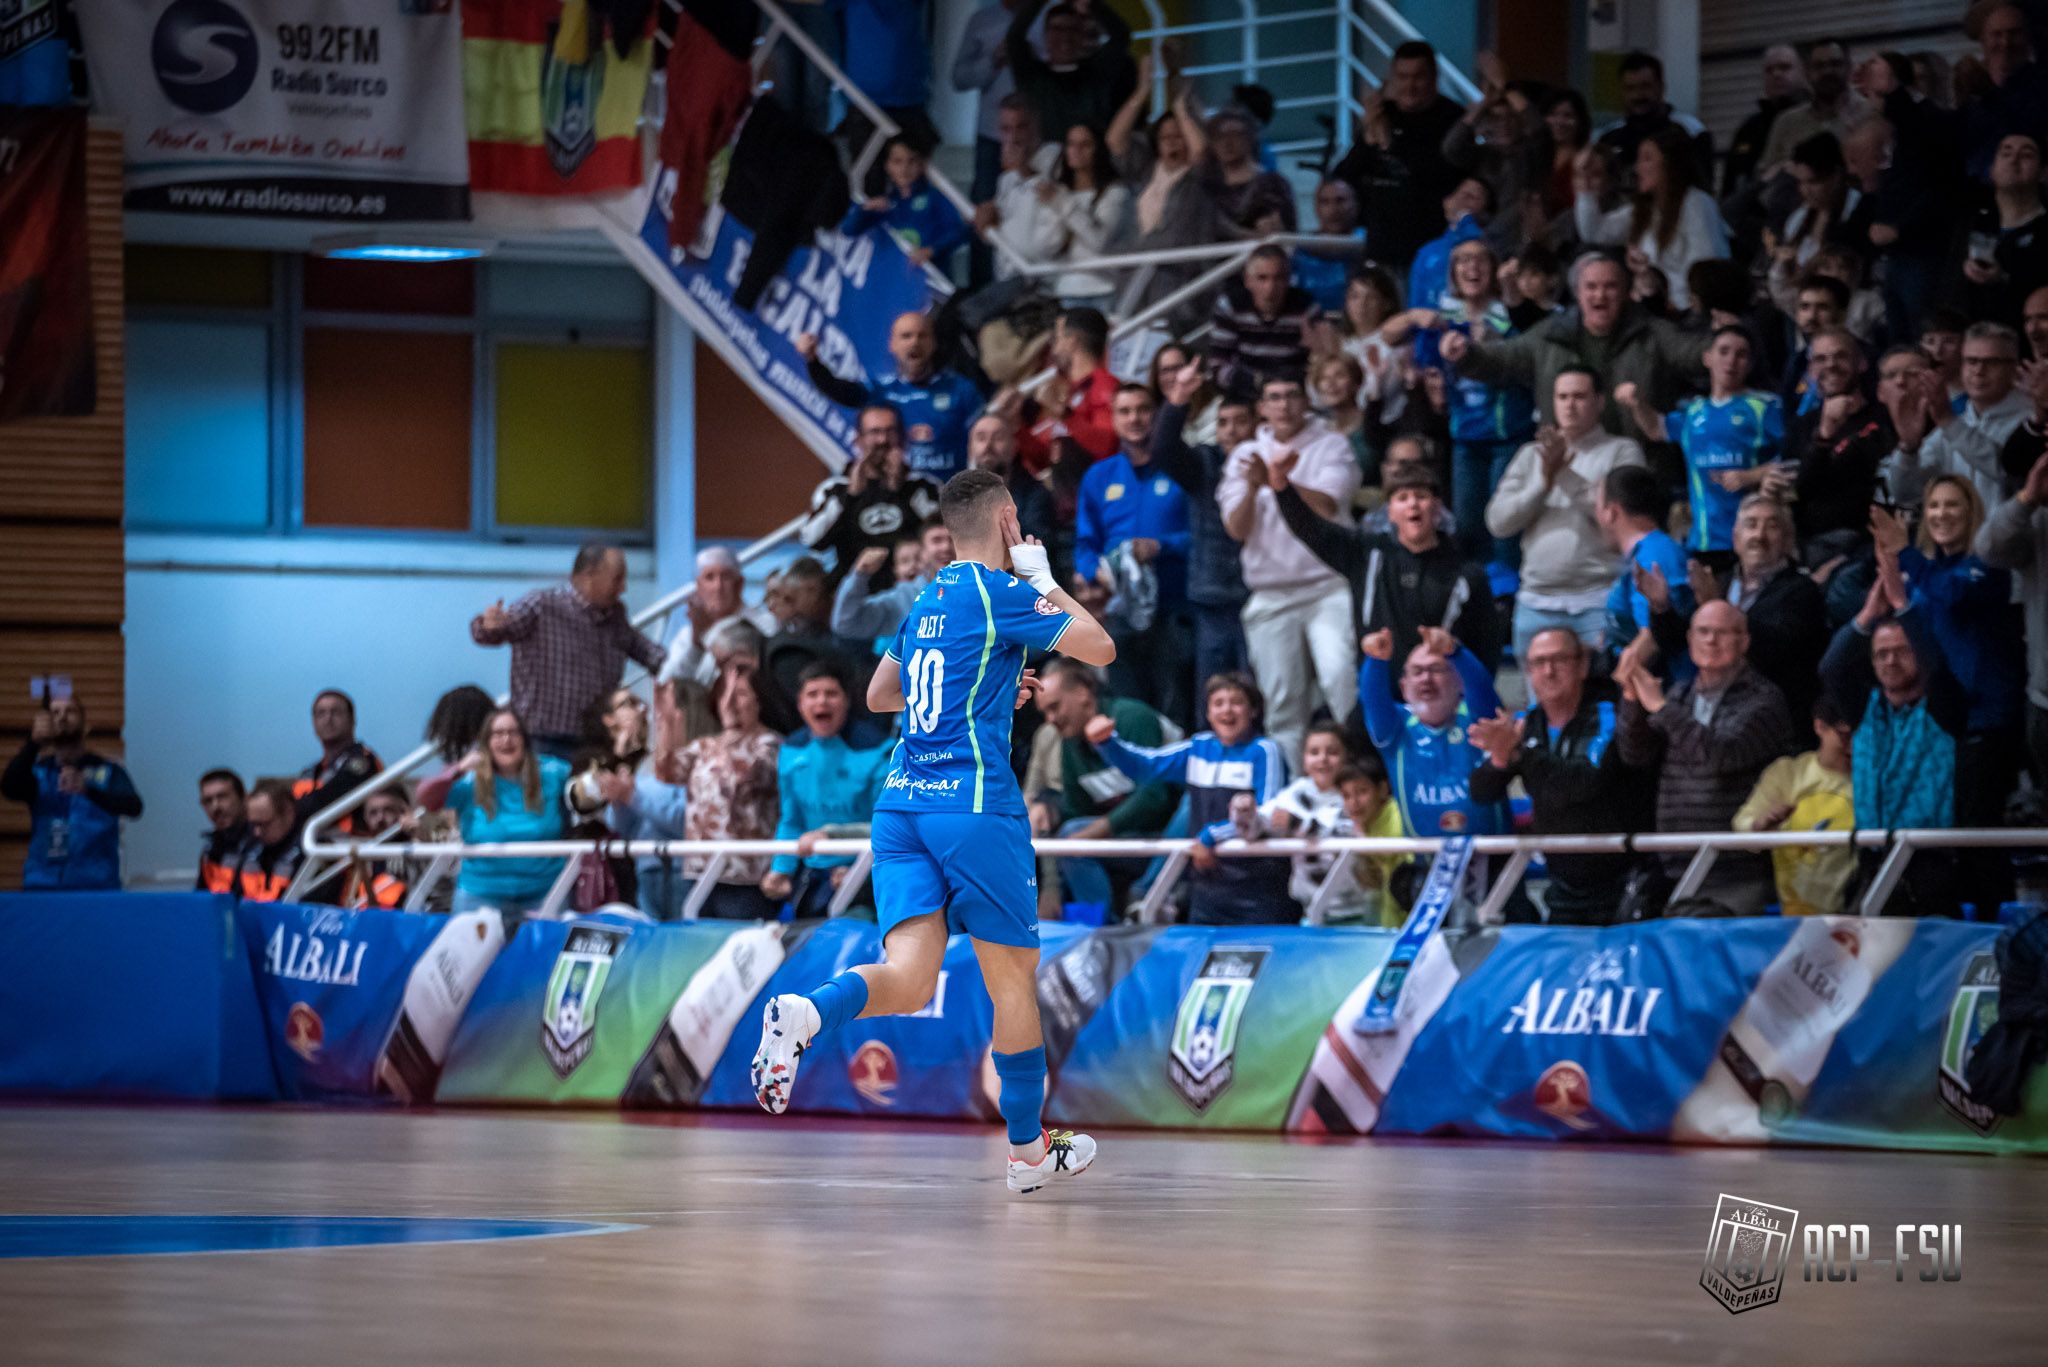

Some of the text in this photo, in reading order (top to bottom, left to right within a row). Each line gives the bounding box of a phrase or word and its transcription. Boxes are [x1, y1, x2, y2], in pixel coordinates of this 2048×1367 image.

[277, 24, 379, 63] 99.2FM
[271, 68, 388, 97] Radio Surco
[167, 184, 387, 215] www.radiosurco.es
[907, 648, 945, 734] 10
[264, 921, 368, 986] ALBALI
[1501, 977, 1663, 1036] ALBALI
